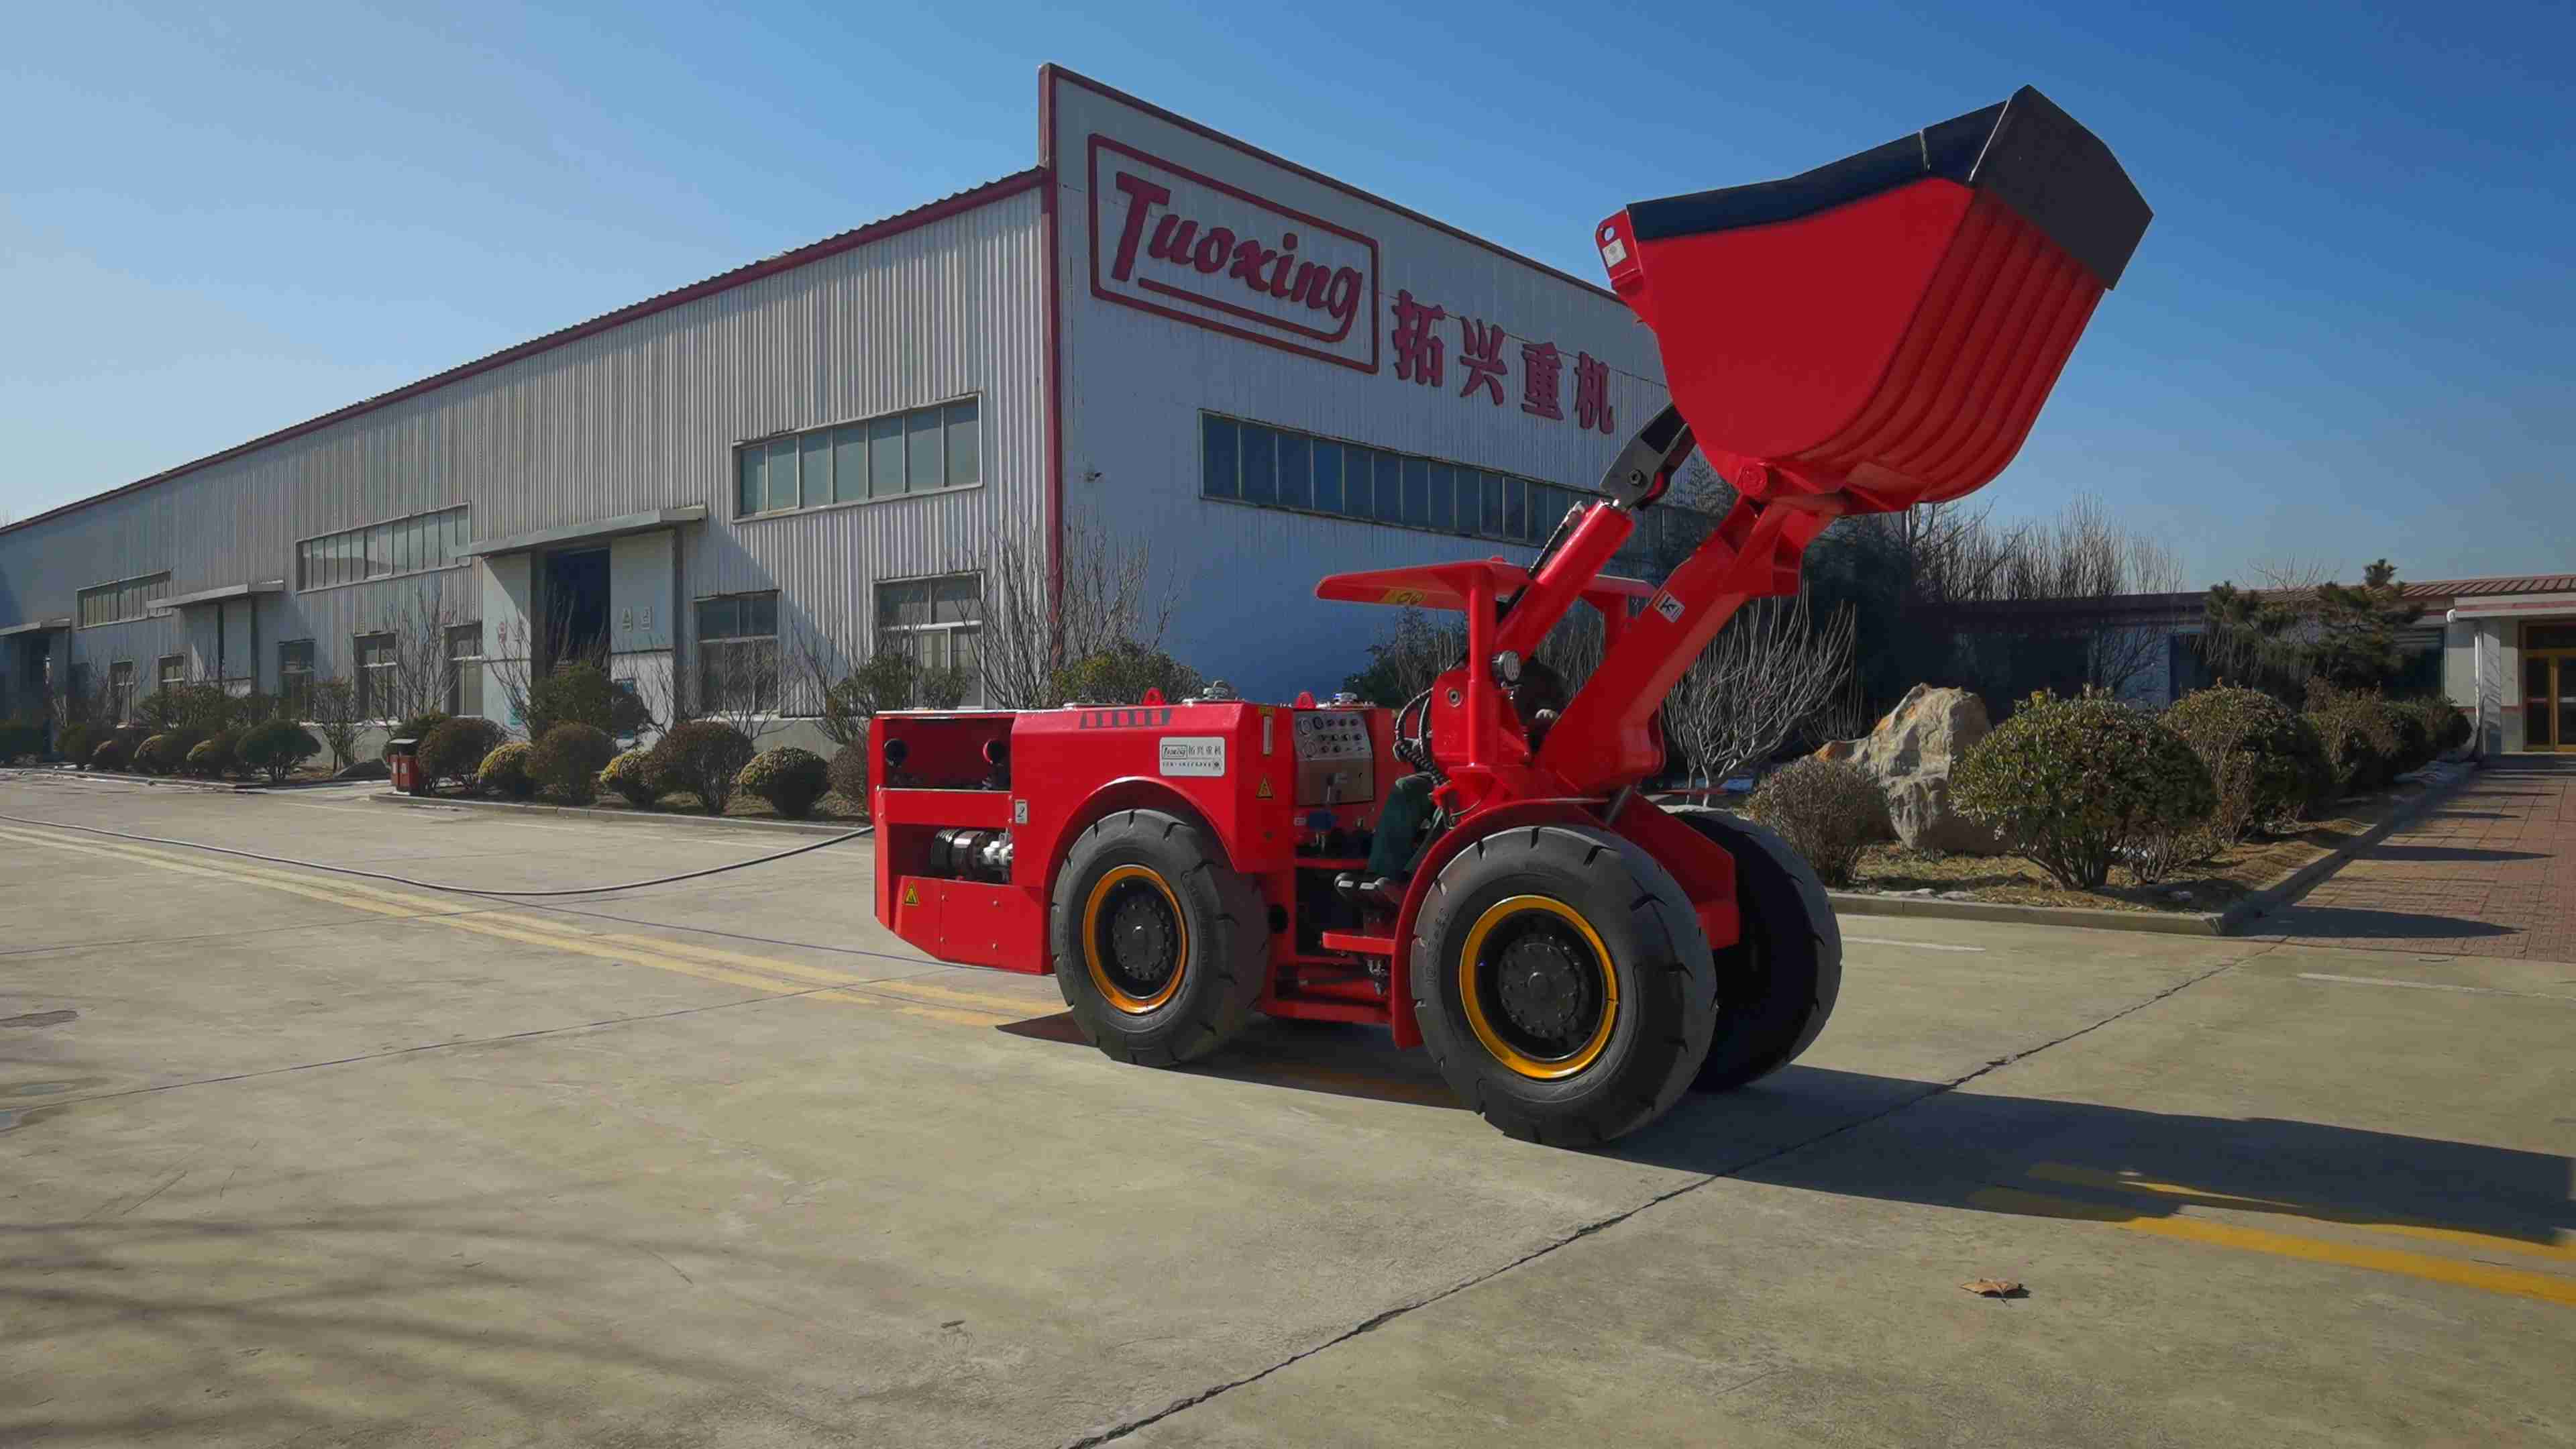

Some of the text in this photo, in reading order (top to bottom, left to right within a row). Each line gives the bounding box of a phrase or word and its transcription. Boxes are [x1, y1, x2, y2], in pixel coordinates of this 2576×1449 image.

[1111, 171, 1363, 343] Tuoxing
[1391, 289, 1614, 435] 拓兴重机
